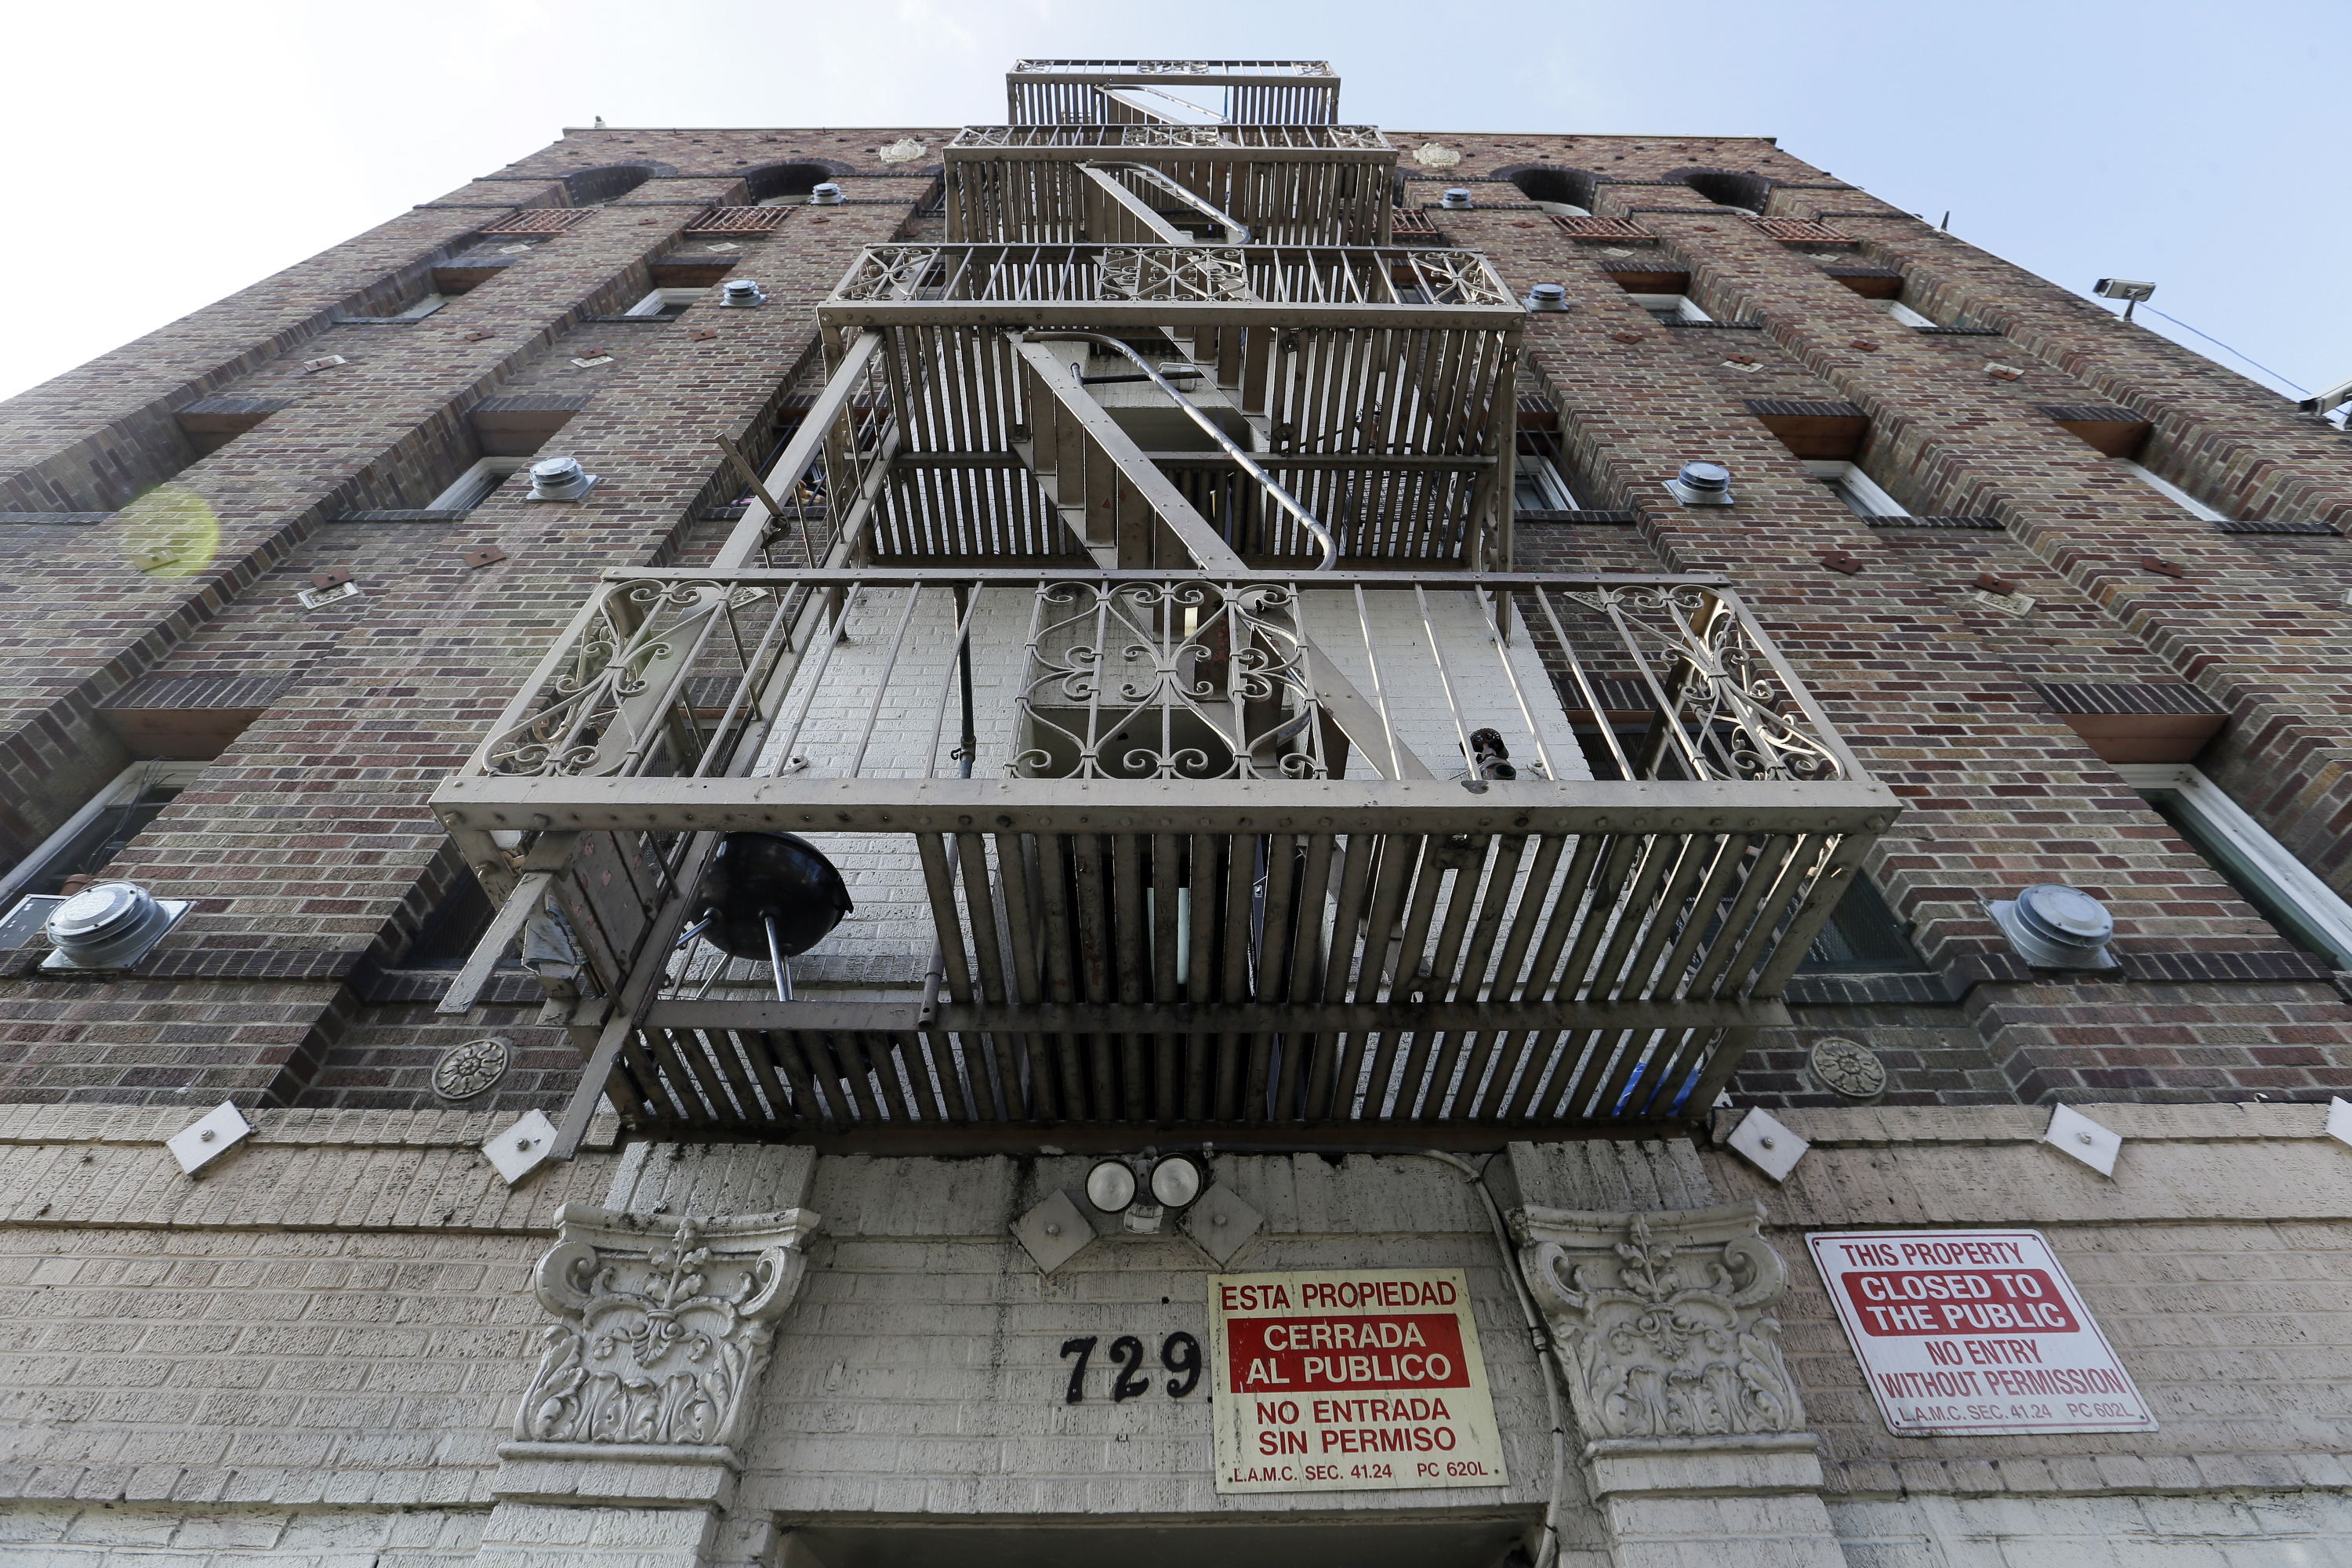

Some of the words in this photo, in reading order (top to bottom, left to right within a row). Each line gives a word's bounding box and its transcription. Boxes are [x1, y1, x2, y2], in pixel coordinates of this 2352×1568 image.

[1840, 1243, 1900, 1267] THIS
[1900, 1243, 2024, 1265] PROPERTY
[1222, 1285, 1290, 1311] ESTA
[1302, 1280, 1457, 1308] PROPIEDAD
[1861, 1276, 1991, 1301] CLOSED
[1991, 1274, 2042, 1298] TO
[1866, 1305, 1940, 1330] THE
[1940, 1302, 2066, 1329] PUBLIC
[1264, 1323, 1425, 1351] CERRADA
[1925, 1341, 1963, 1365] NO
[1962, 1340, 2042, 1363] ENTRY
[1060, 1331, 1202, 1404] 729
[1247, 1358, 1290, 1385] AL
[1305, 1353, 1451, 1382] PUBLICO
[1878, 1370, 1982, 1398] WITHOUT
[1982, 1369, 2127, 1396] PERMISSION
[1257, 1400, 1300, 1425] NO
[1314, 1398, 1450, 1422] ENTRADA
[1897, 1405, 1967, 1422] L.A.M.C.
[1969, 1405, 2009, 1421] SEC.
[2011, 1404, 2053, 1419] 41.24
[2066, 1403, 2092, 1418] PC
[2095, 1403, 2135, 1417] 602L
[1259, 1431, 1308, 1455] SIN
[1322, 1427, 1457, 1453] PERMISO
[1233, 1465, 1298, 1483] L.A.M.C.
[1305, 1464, 1344, 1480] SEC.
[1350, 1464, 1392, 1479] 41.24
[1417, 1462, 1439, 1478] PC
[1446, 1461, 1488, 1476] 620L
